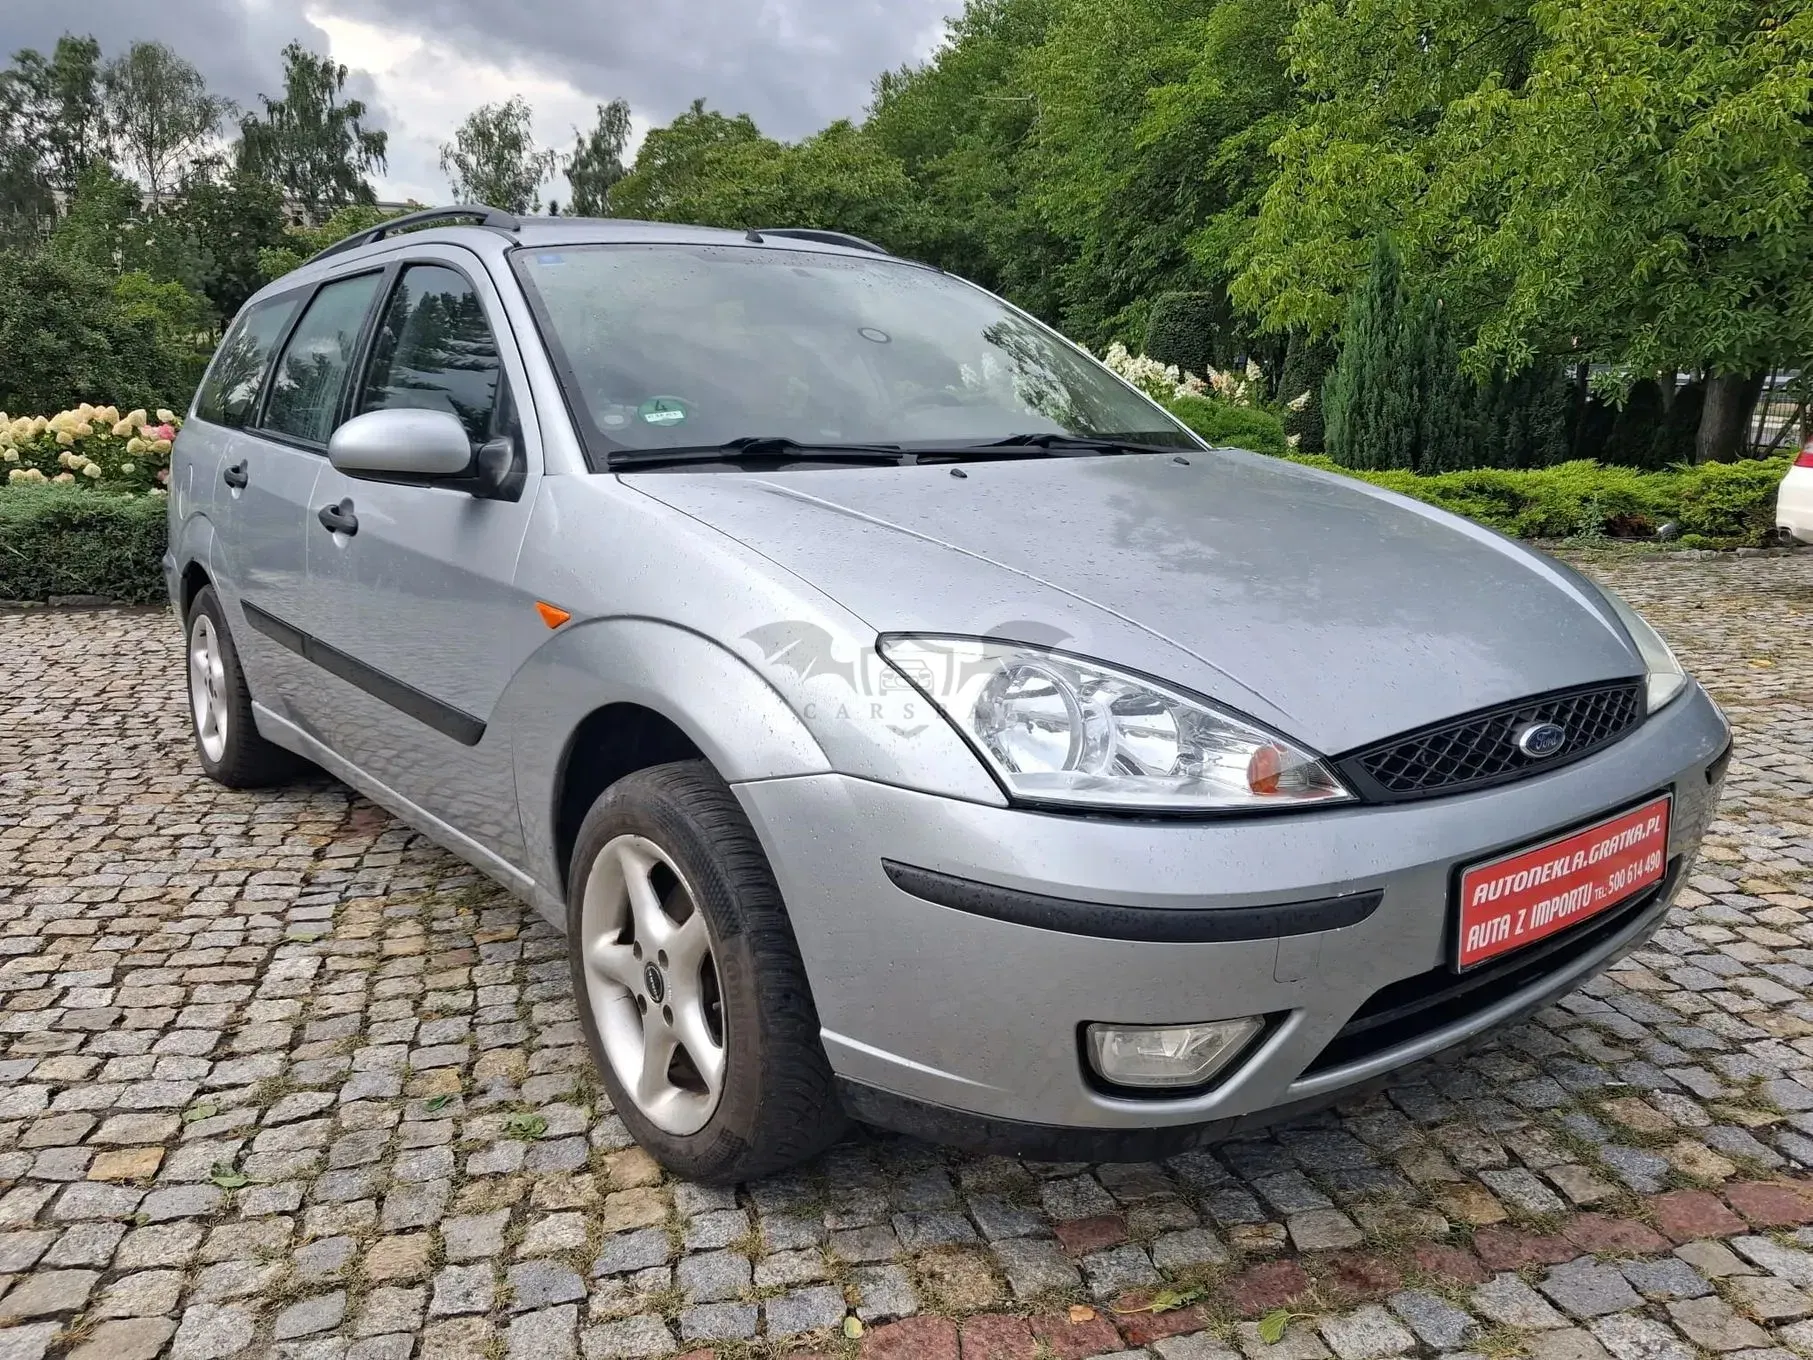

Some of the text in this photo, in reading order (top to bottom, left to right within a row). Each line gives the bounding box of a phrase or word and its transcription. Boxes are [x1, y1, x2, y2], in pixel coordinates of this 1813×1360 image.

[1466, 913, 1511, 952] AUTA
[1514, 908, 1527, 935] Z
[1529, 881, 1593, 930] IMPORTU
[1608, 869, 1626, 895] 500
[1627, 859, 1643, 884] 614
[1644, 849, 1661, 874] 490
[1472, 815, 1661, 907] AUTONEKLA.GRATKA.PL
